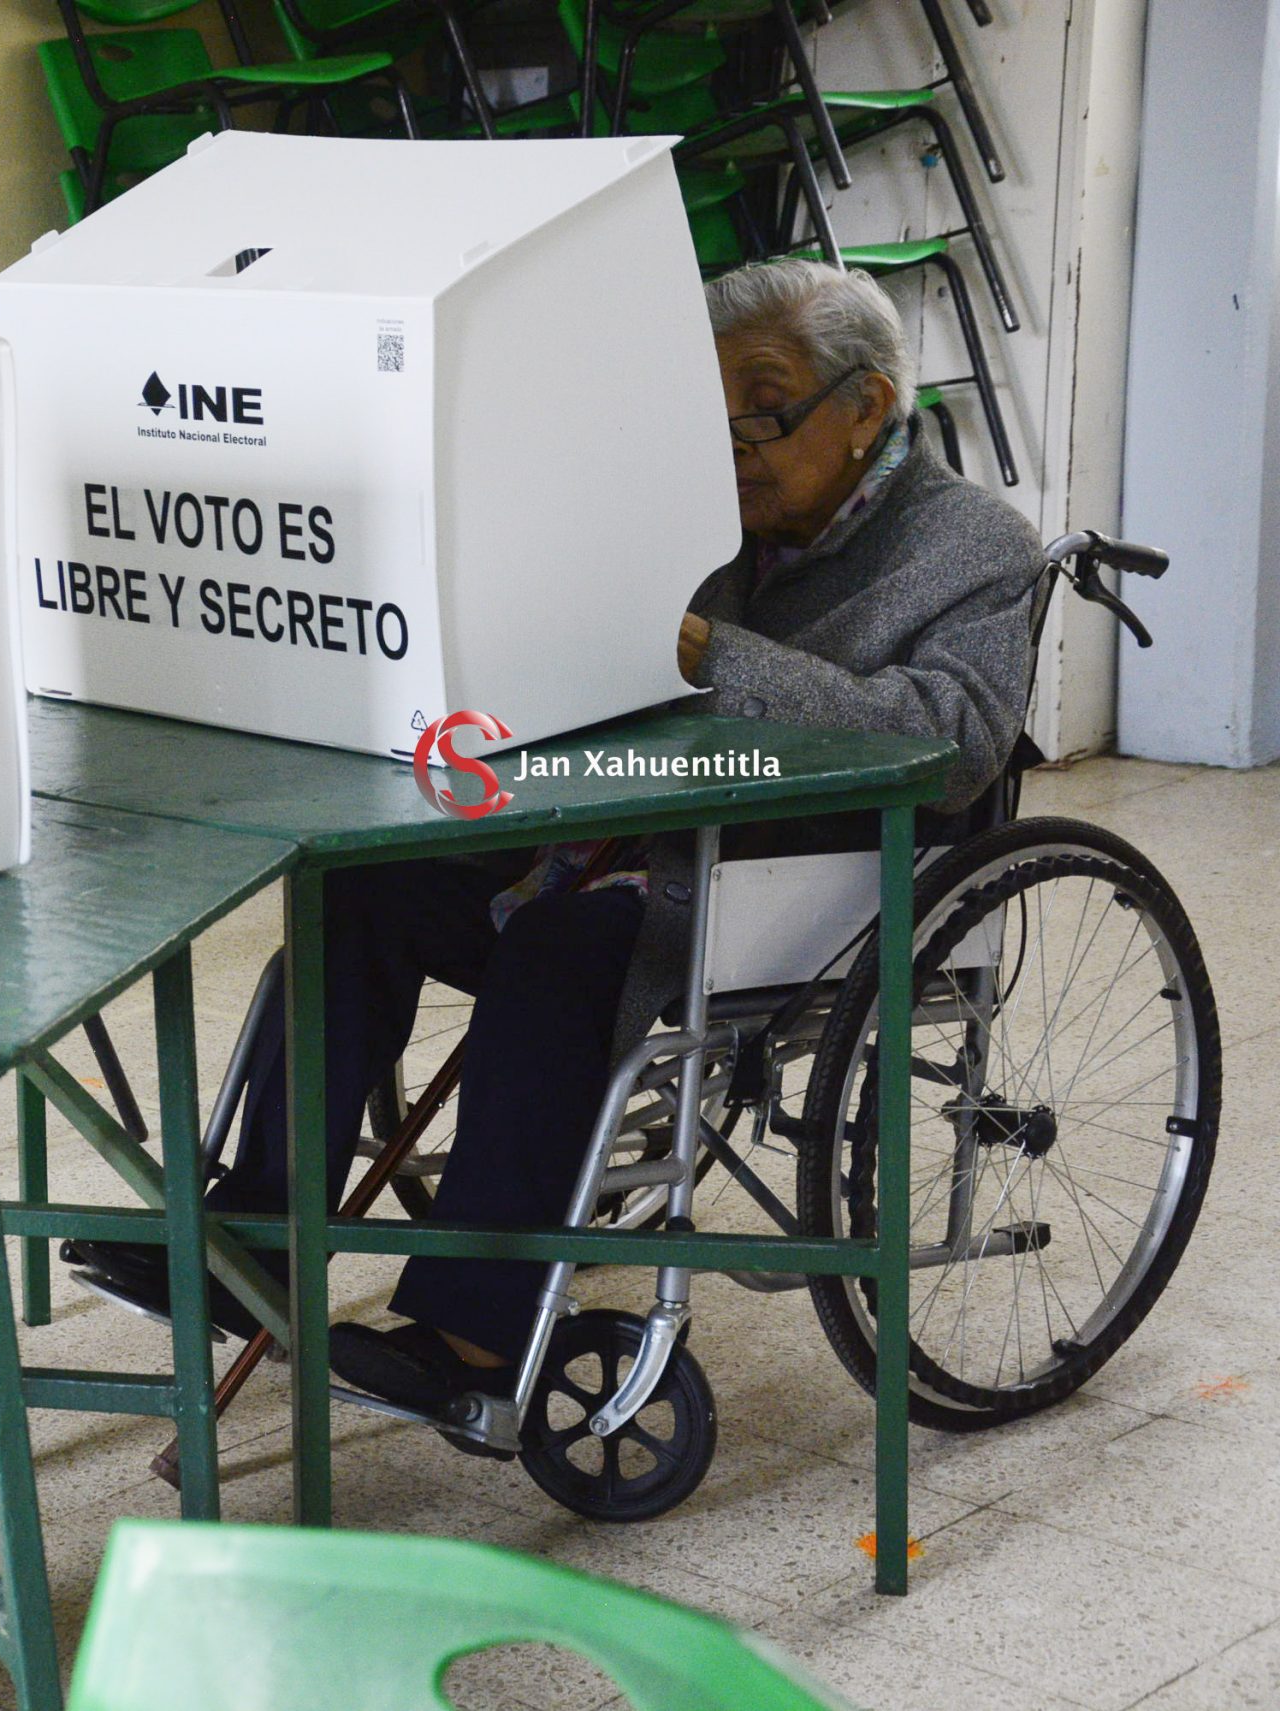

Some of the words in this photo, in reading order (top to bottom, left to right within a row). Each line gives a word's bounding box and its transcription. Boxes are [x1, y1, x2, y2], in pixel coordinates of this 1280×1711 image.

[178, 384, 264, 425] INE
[137, 426, 176, 439] Instituto
[179, 430, 220, 443] Nacional
[223, 433, 267, 446] Electoral
[84, 482, 136, 541] EL
[143, 488, 264, 555] VOTO
[278, 502, 337, 565] ES
[34, 557, 151, 624] LIBRE
[158, 573, 186, 628] Y
[199, 578, 410, 661] SECRETO
